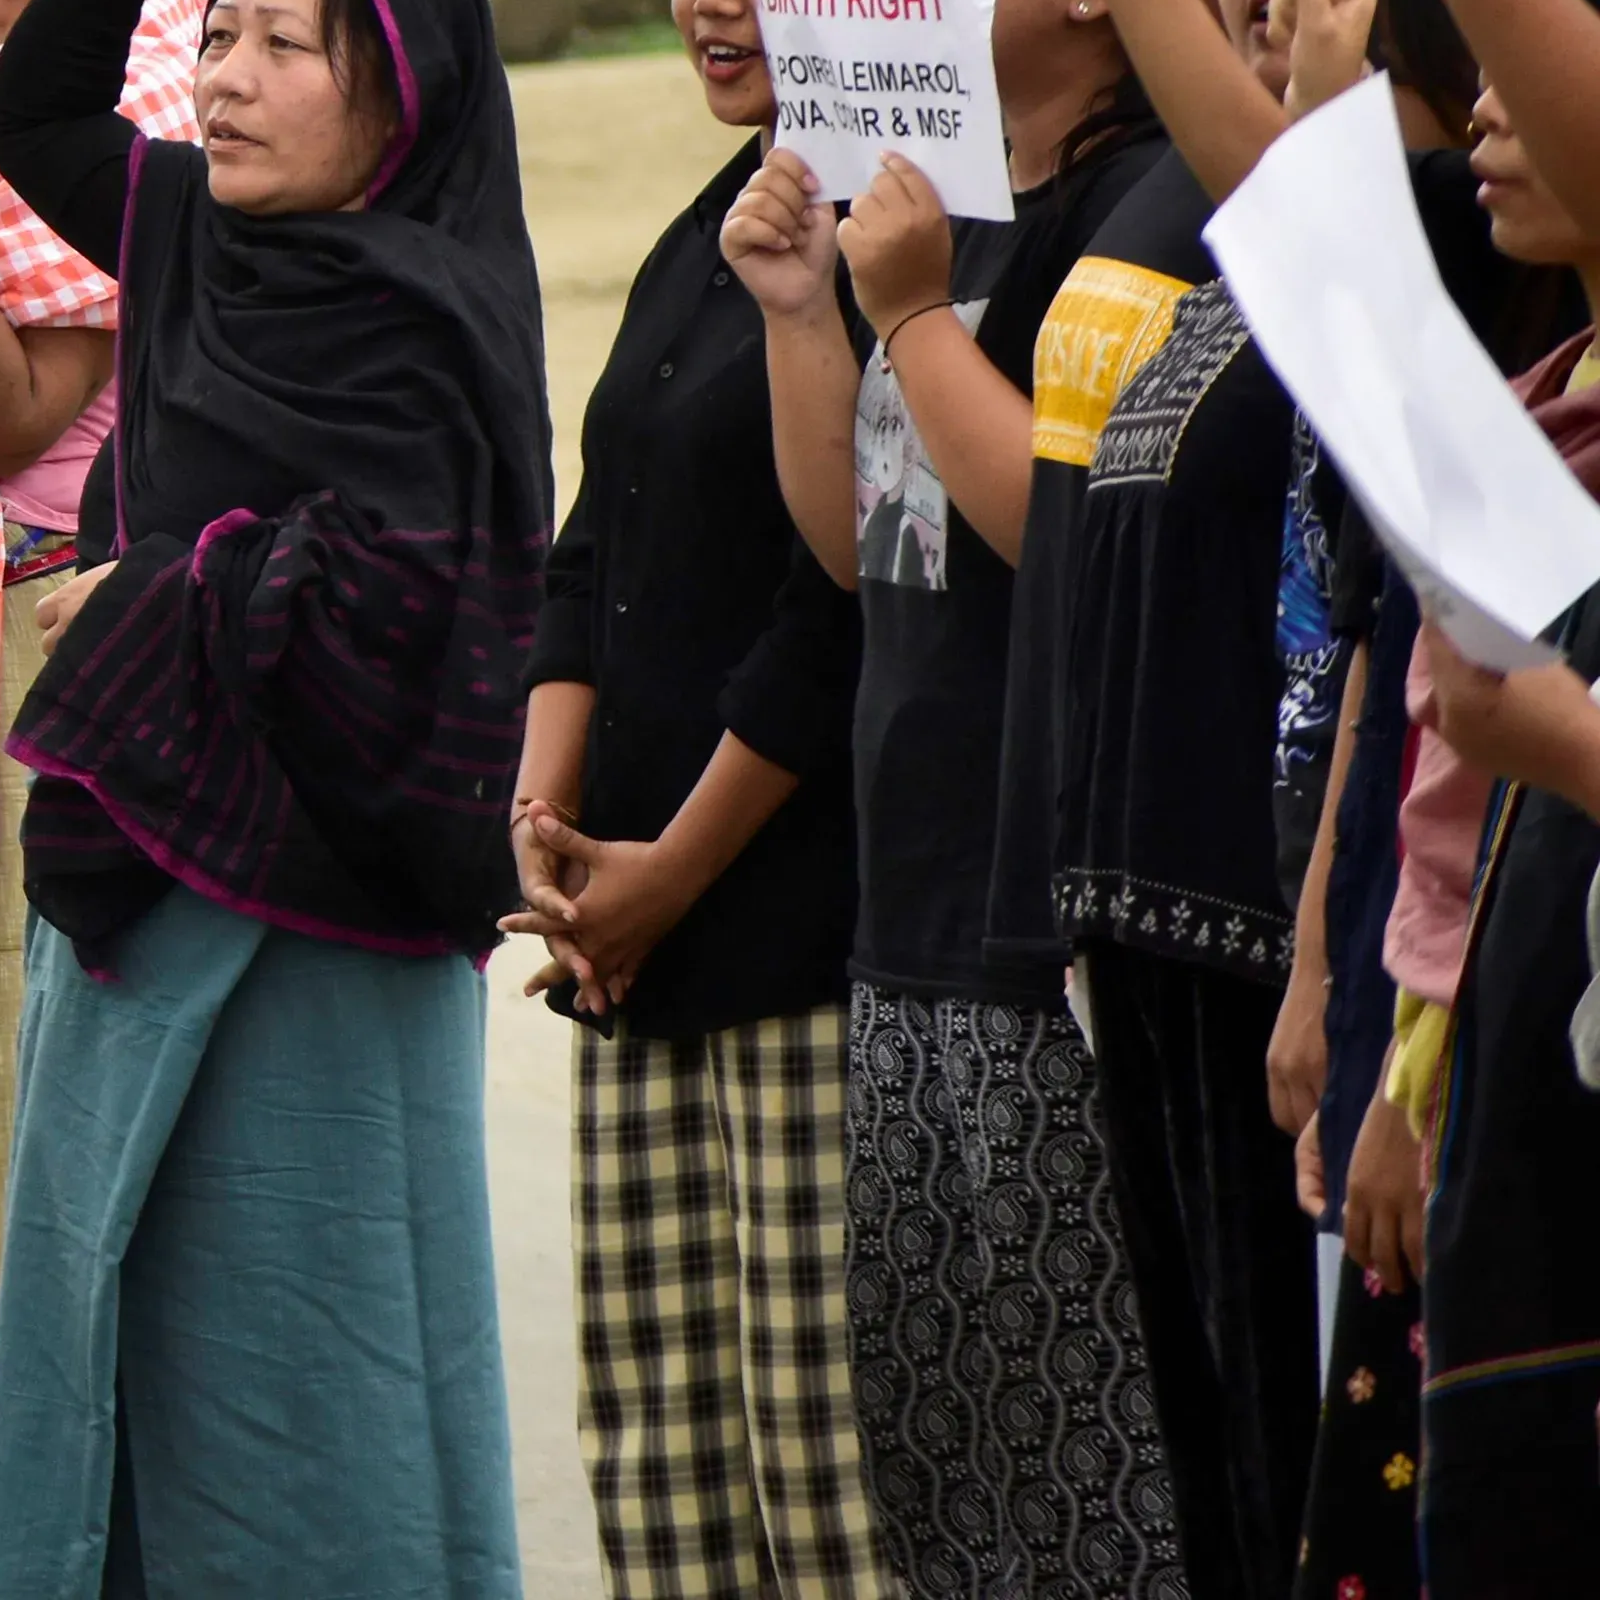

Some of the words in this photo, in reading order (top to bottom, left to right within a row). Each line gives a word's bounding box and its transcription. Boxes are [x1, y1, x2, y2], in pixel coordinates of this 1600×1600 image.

[839, 61, 971, 102] LEIMAROL,
[892, 107, 911, 137] &
[916, 107, 963, 140] MSF
